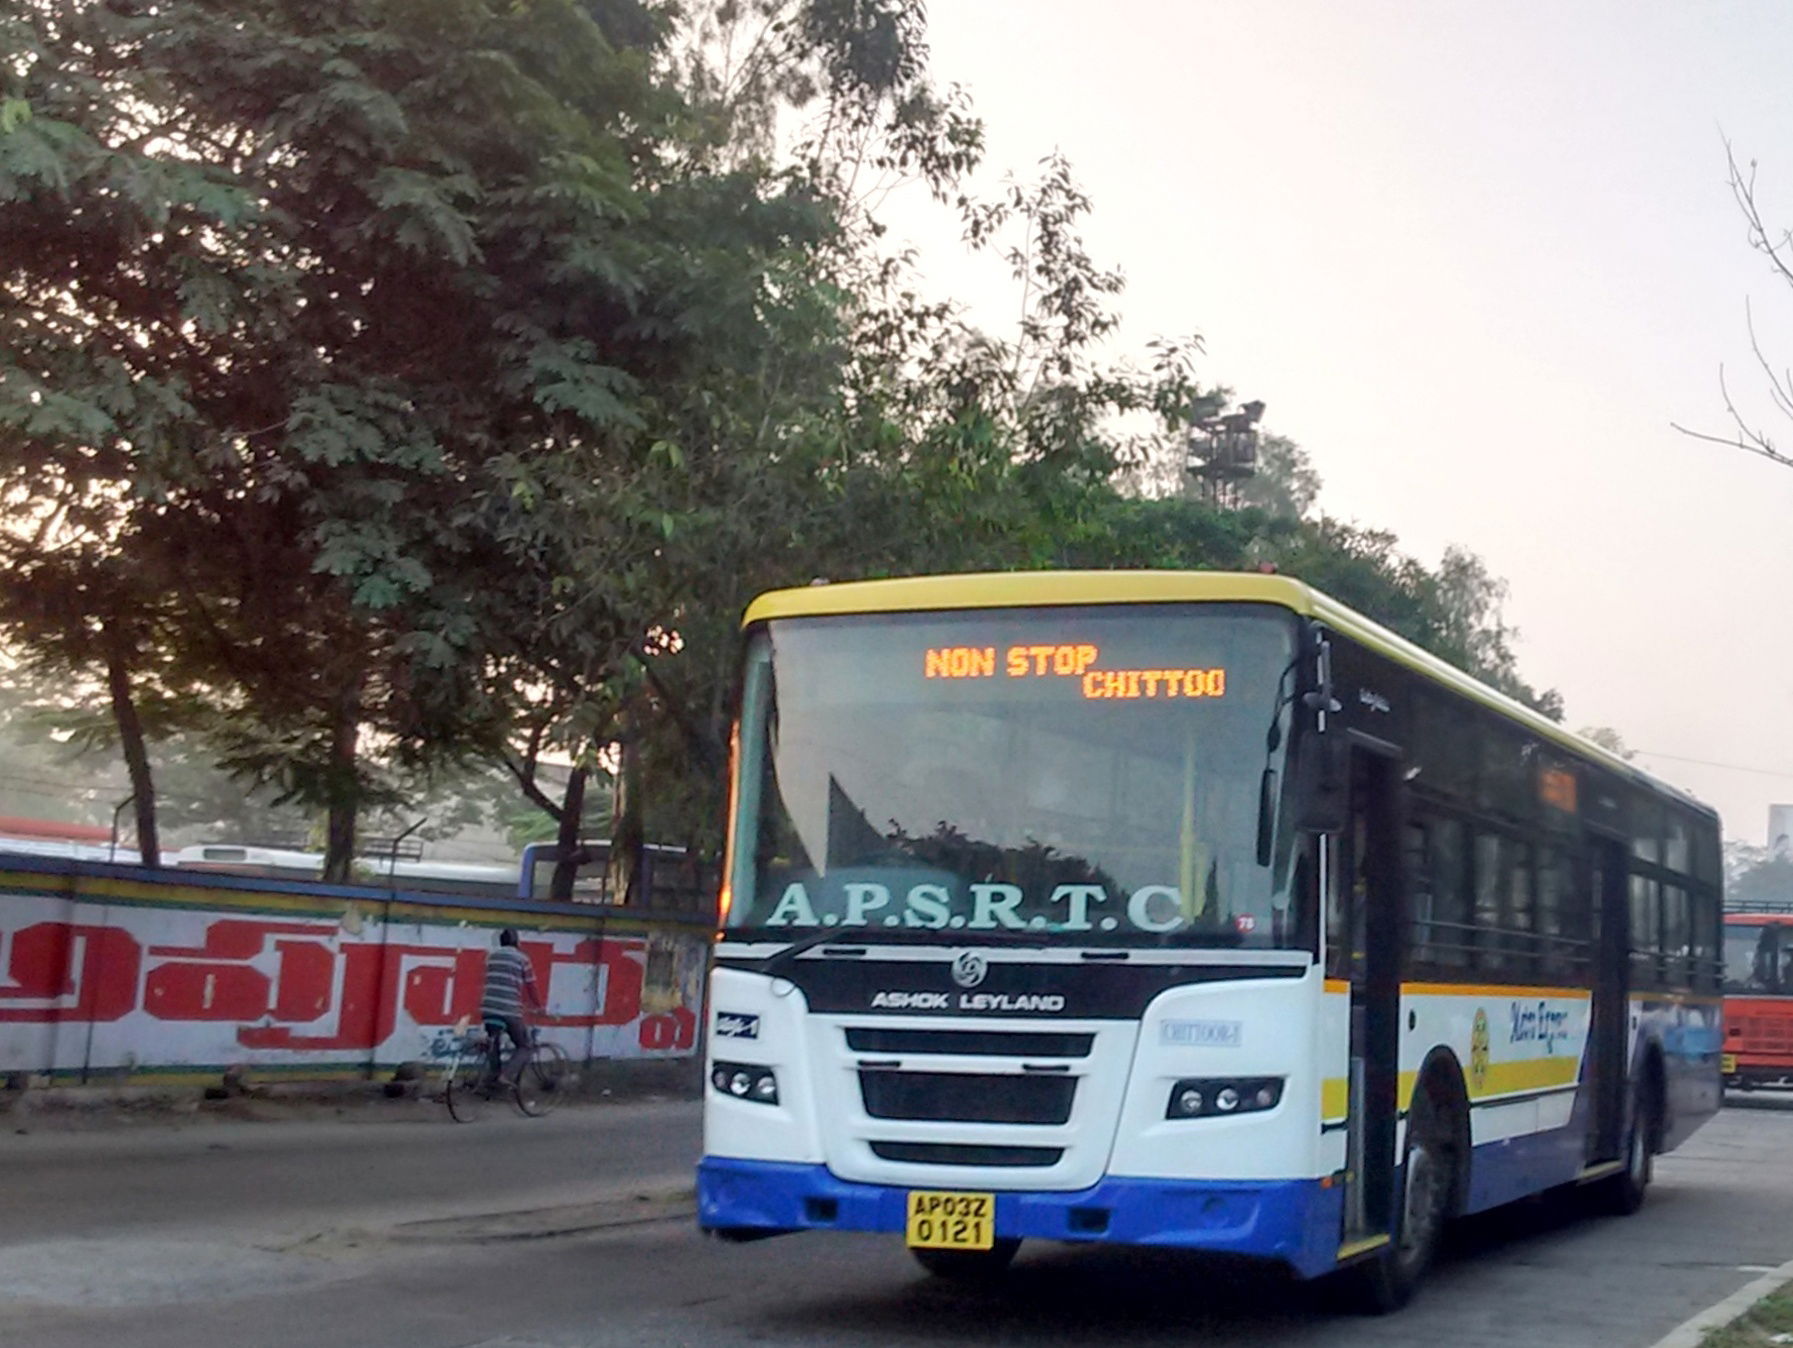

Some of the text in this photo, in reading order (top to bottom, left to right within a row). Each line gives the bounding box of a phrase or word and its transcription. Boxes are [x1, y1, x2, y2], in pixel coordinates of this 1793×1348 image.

[924, 645, 1098, 678] NON STOP
[1083, 669, 1225, 698] CHITTOO
[766, 882, 1184, 932] A.P.S.R.T.C
[871, 992, 1065, 1011] ASHOK LEYLAND
[914, 1196, 988, 1218] AP03Z
[917, 1218, 983, 1244] 0121
